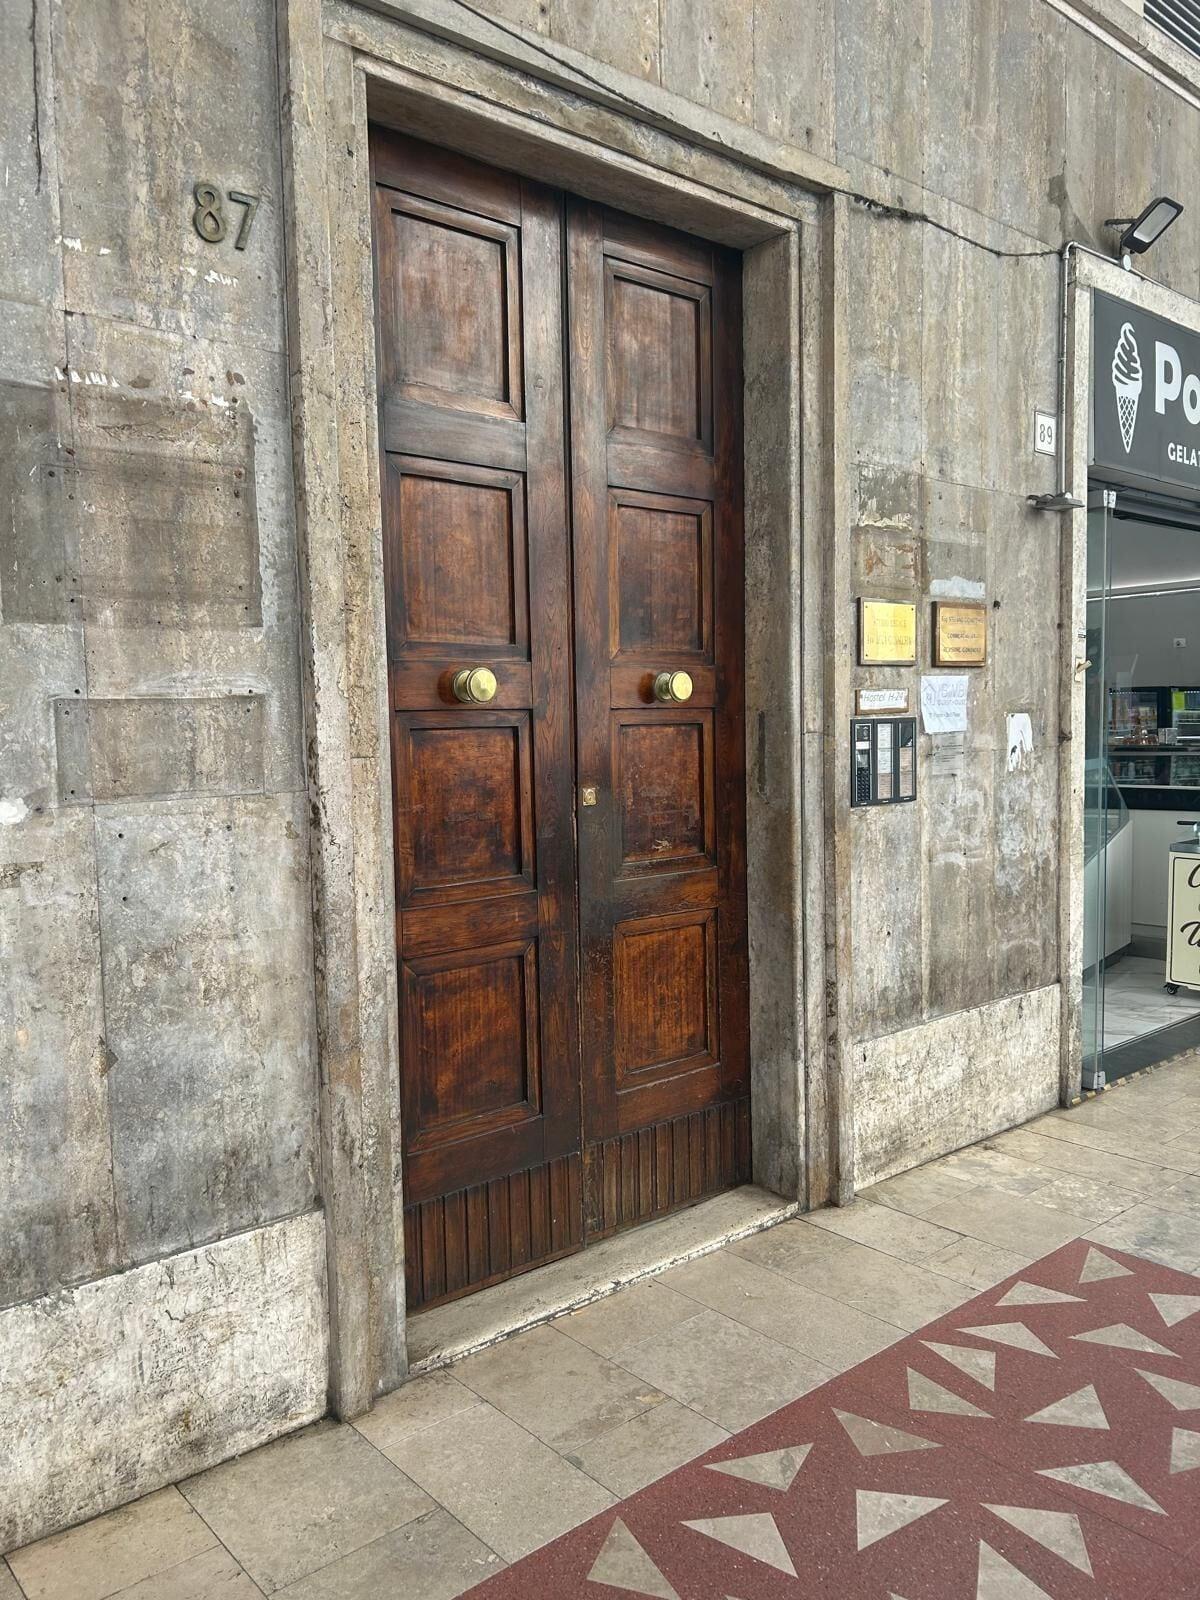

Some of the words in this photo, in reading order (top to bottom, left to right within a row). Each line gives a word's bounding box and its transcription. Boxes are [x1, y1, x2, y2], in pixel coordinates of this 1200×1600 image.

[193, 183, 259, 251] 87
[1155, 340, 1200, 425] Po
[1039, 423, 1053, 445] 89
